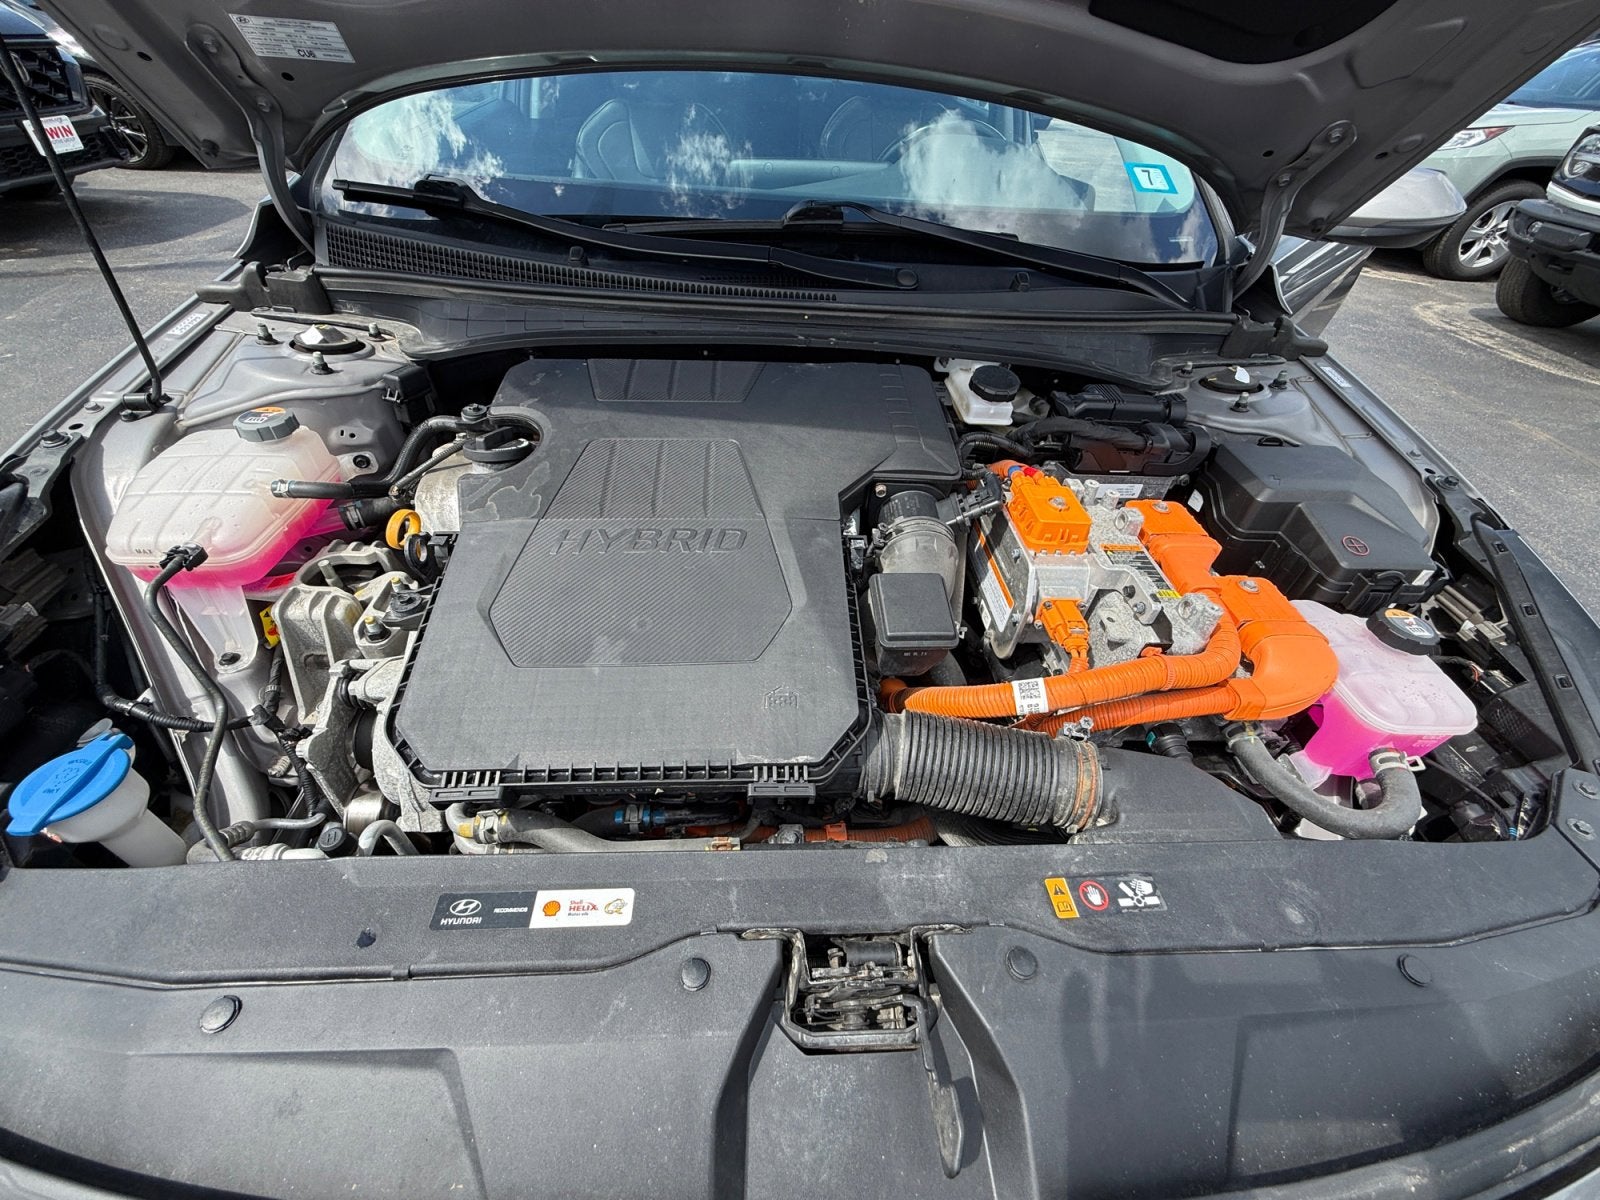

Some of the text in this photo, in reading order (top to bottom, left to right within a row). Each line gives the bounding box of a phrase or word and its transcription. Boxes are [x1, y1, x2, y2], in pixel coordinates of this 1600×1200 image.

[45, 125, 74, 140] WIN
[1141, 169, 1153, 186] 7
[549, 528, 748, 554] HYBRID
[568, 903, 598, 912] HELIX
[440, 917, 482, 926] HYUNDAI
